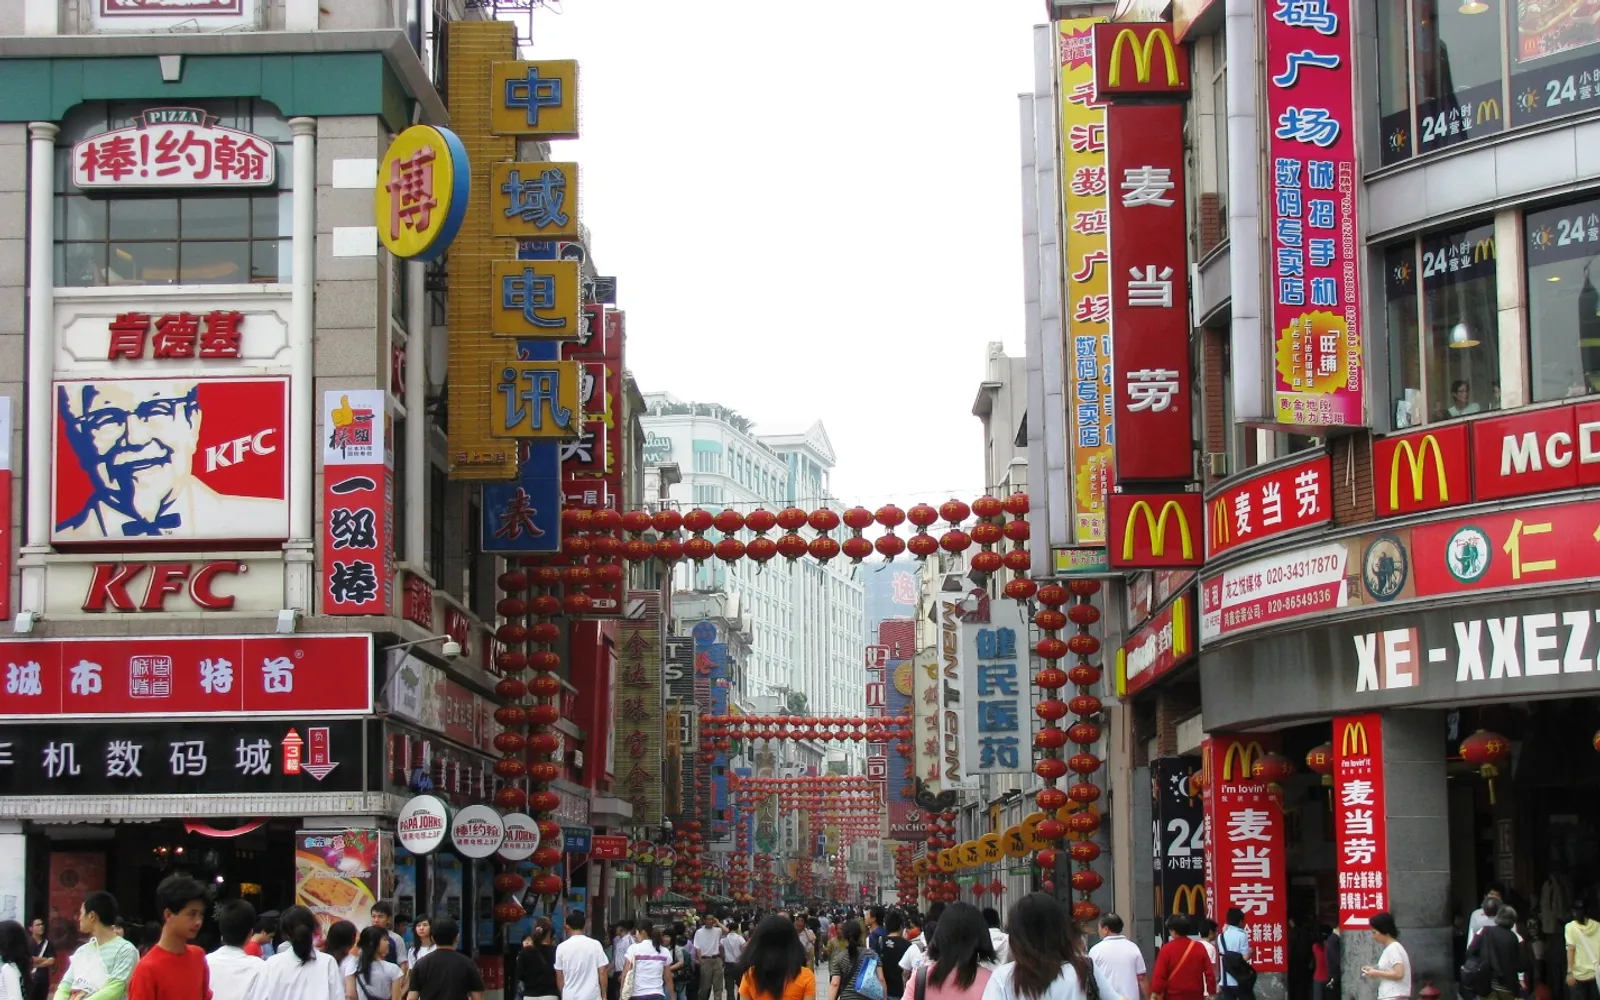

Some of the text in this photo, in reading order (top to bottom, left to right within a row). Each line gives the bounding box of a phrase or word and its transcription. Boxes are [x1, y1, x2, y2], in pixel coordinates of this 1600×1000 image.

[1449, 102, 1472, 121] 小时
[1545, 75, 1577, 107] 24
[149, 109, 199, 124] PIZZA
[1421, 112, 1448, 142] 24
[1449, 118, 1473, 136] 营业
[385, 144, 438, 241] 博
[498, 65, 571, 431] 中域电讯
[1276, 158, 1304, 305] 数码专卖店
[1308, 160, 1338, 306] 诚招手机
[1557, 215, 1585, 246] 24
[1422, 248, 1448, 278] 24
[1121, 166, 1180, 412] 麦当劳
[109, 311, 244, 359] 肯德基
[205, 428, 276, 473] KFC
[1234, 470, 1320, 537] 麦当劳
[330, 476, 379, 605] 一级棒
[81, 561, 240, 613] KFC
[1266, 554, 1339, 585] 020-34317870
[1341, 779, 1376, 865] 麦当劳
[1226, 808, 1275, 916] 麦当劳
